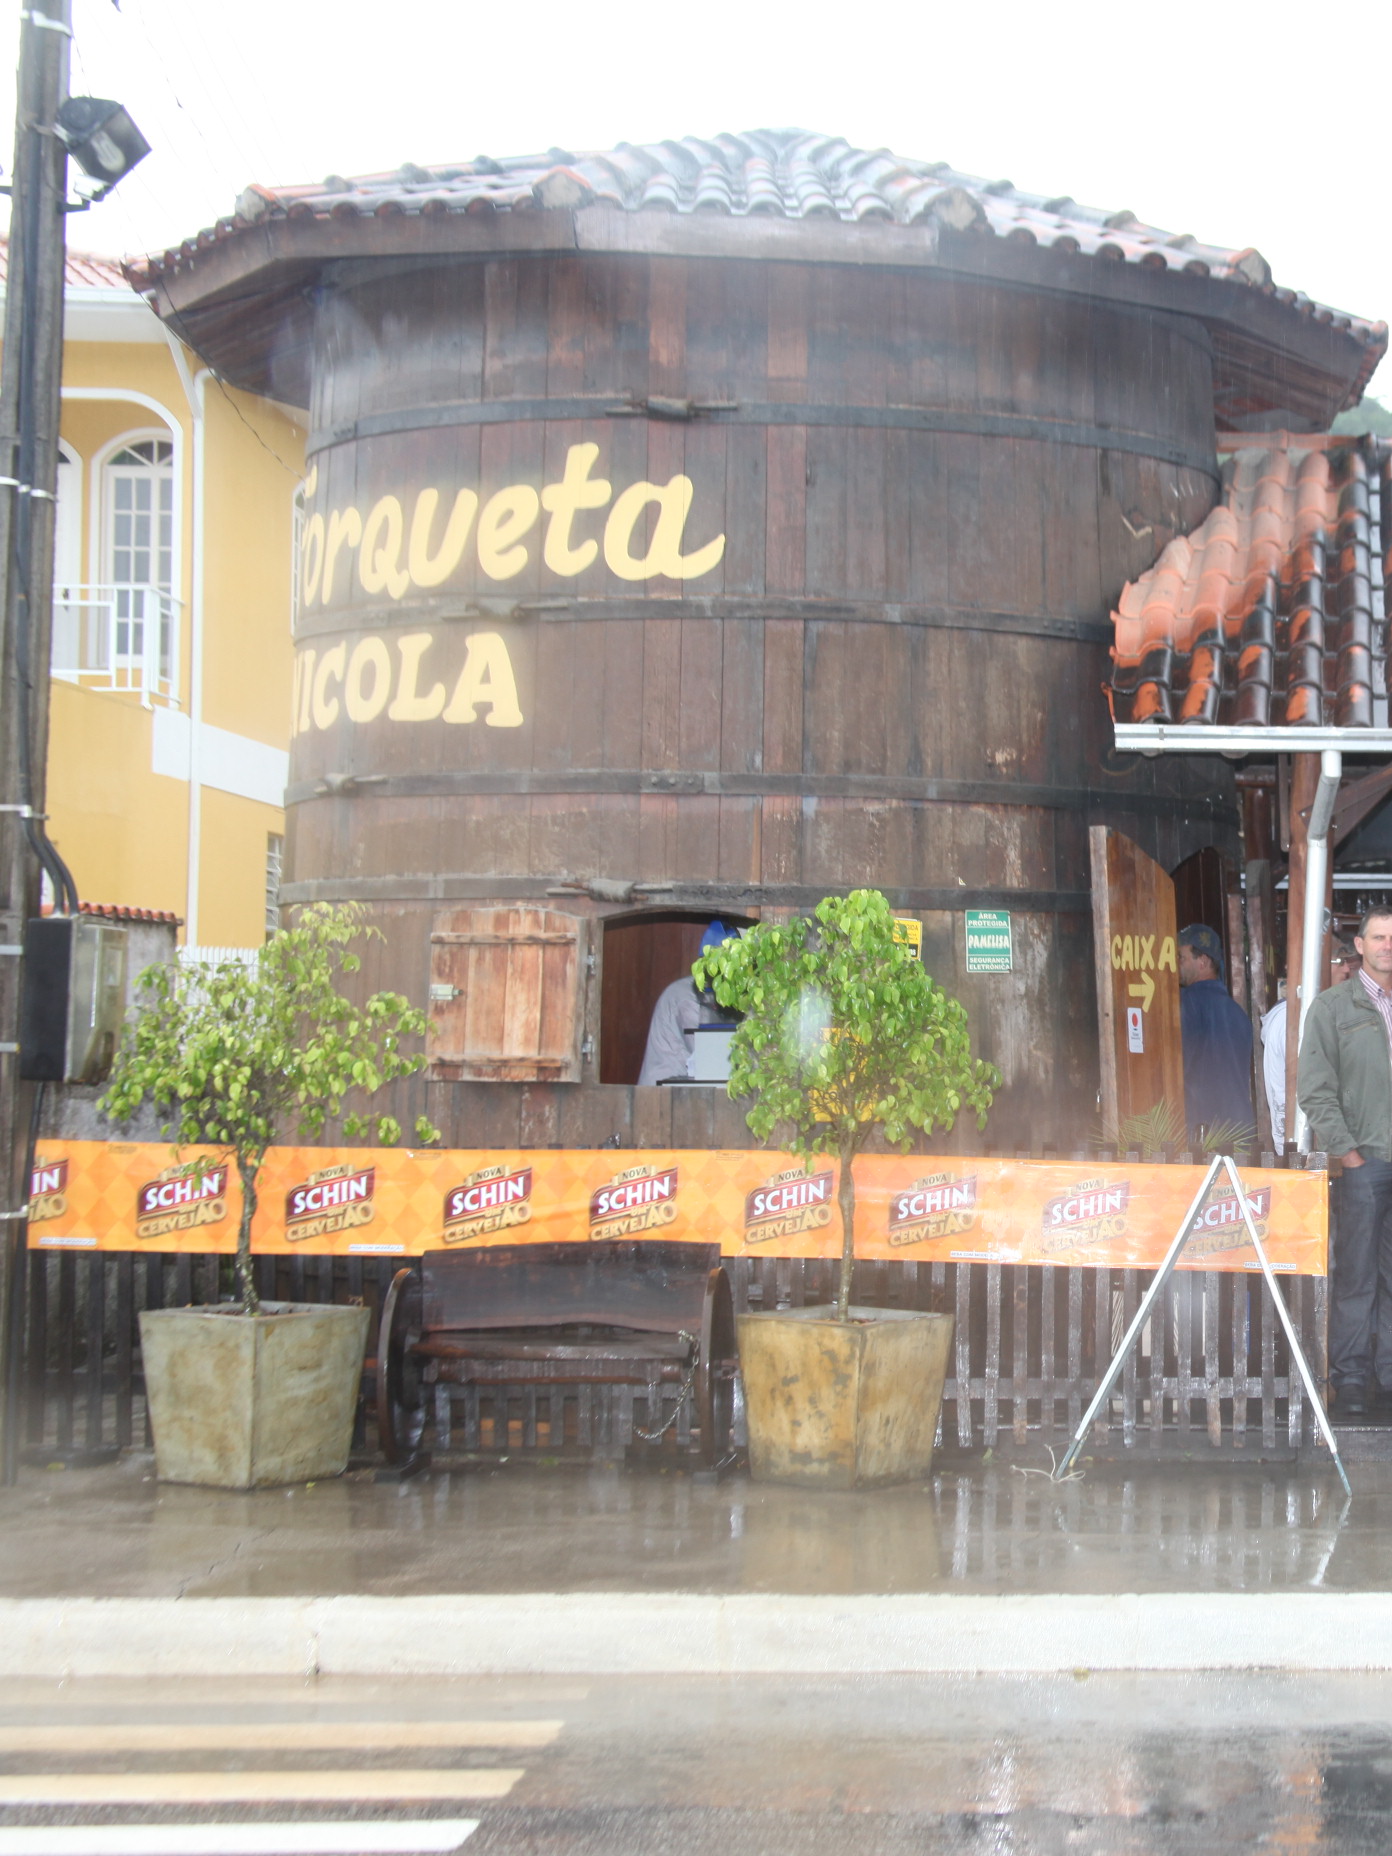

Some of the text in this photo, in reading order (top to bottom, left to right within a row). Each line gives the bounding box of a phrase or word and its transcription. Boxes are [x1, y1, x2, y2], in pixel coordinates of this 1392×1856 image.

[978, 912, 998, 920] ÁREA
[968, 920, 1008, 928] PROTEGIDA
[1111, 933, 1177, 974] CAIXA
[319, 1167, 345, 1178] NOVA
[476, 1167, 502, 1179] NOVA
[622, 1167, 648, 1179] NOVA
[777, 1169, 803, 1182] NOVA
[921, 1173, 947, 1186] NOVA
[1075, 1179, 1101, 1192] NOVA
[293, 1175, 368, 1214] SCHIN
[451, 1175, 525, 1215] SCHIN
[598, 1175, 670, 1214] SCHIN
[753, 1179, 825, 1216] SCHIN
[897, 1183, 969, 1220] SCHIN
[1051, 1189, 1122, 1225] SCHIN
